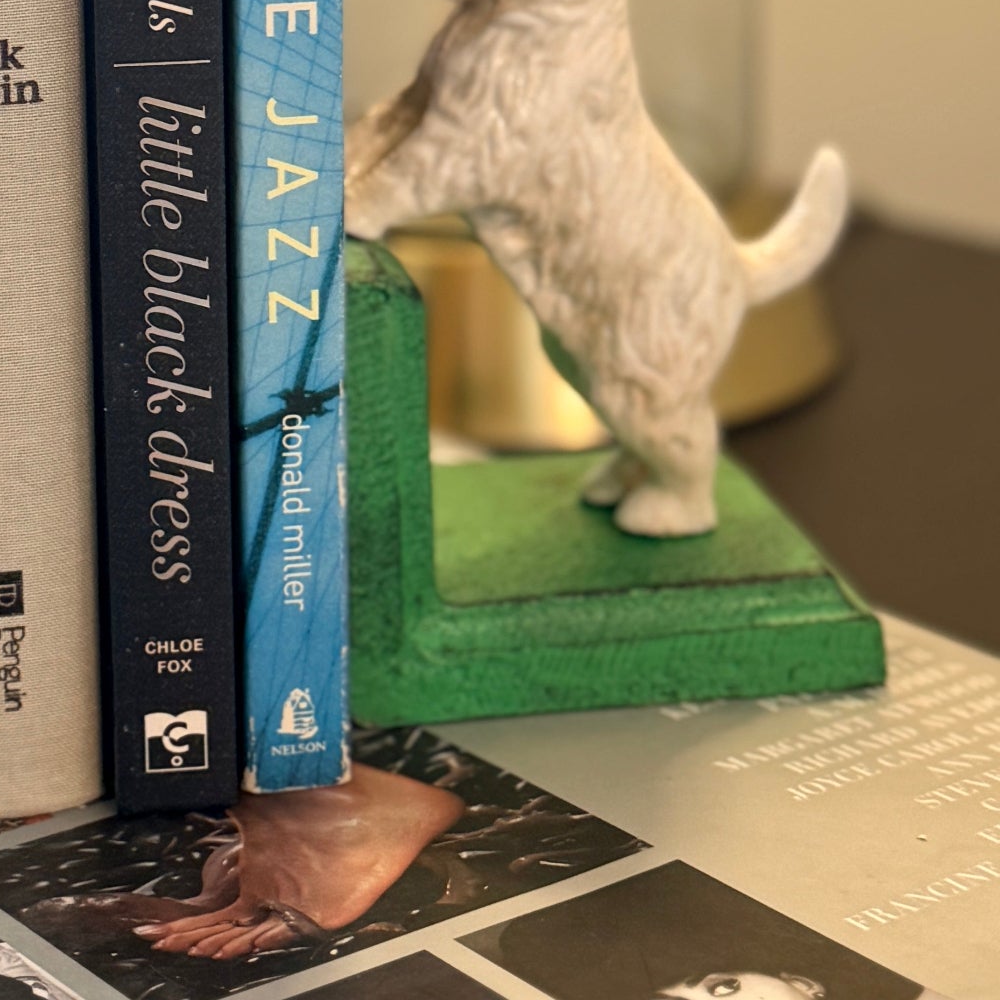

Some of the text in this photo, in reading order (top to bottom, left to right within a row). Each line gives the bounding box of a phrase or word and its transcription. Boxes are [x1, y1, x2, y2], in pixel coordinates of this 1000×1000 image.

[137, 96, 208, 230] little
[266, 97, 320, 324] JAZZ
[142, 249, 213, 414] black
[148, 430, 215, 584] dress
[281, 413, 313, 612] donald miller
[144, 638, 204, 654] CHLOE
[157, 659, 193, 674] FOX
[271, 741, 326, 756] NELSON
[783, 725, 919, 775] RICHARD
[787, 732, 980, 801] JOYCE CAROL
[843, 861, 1000, 931] FRANCINE
